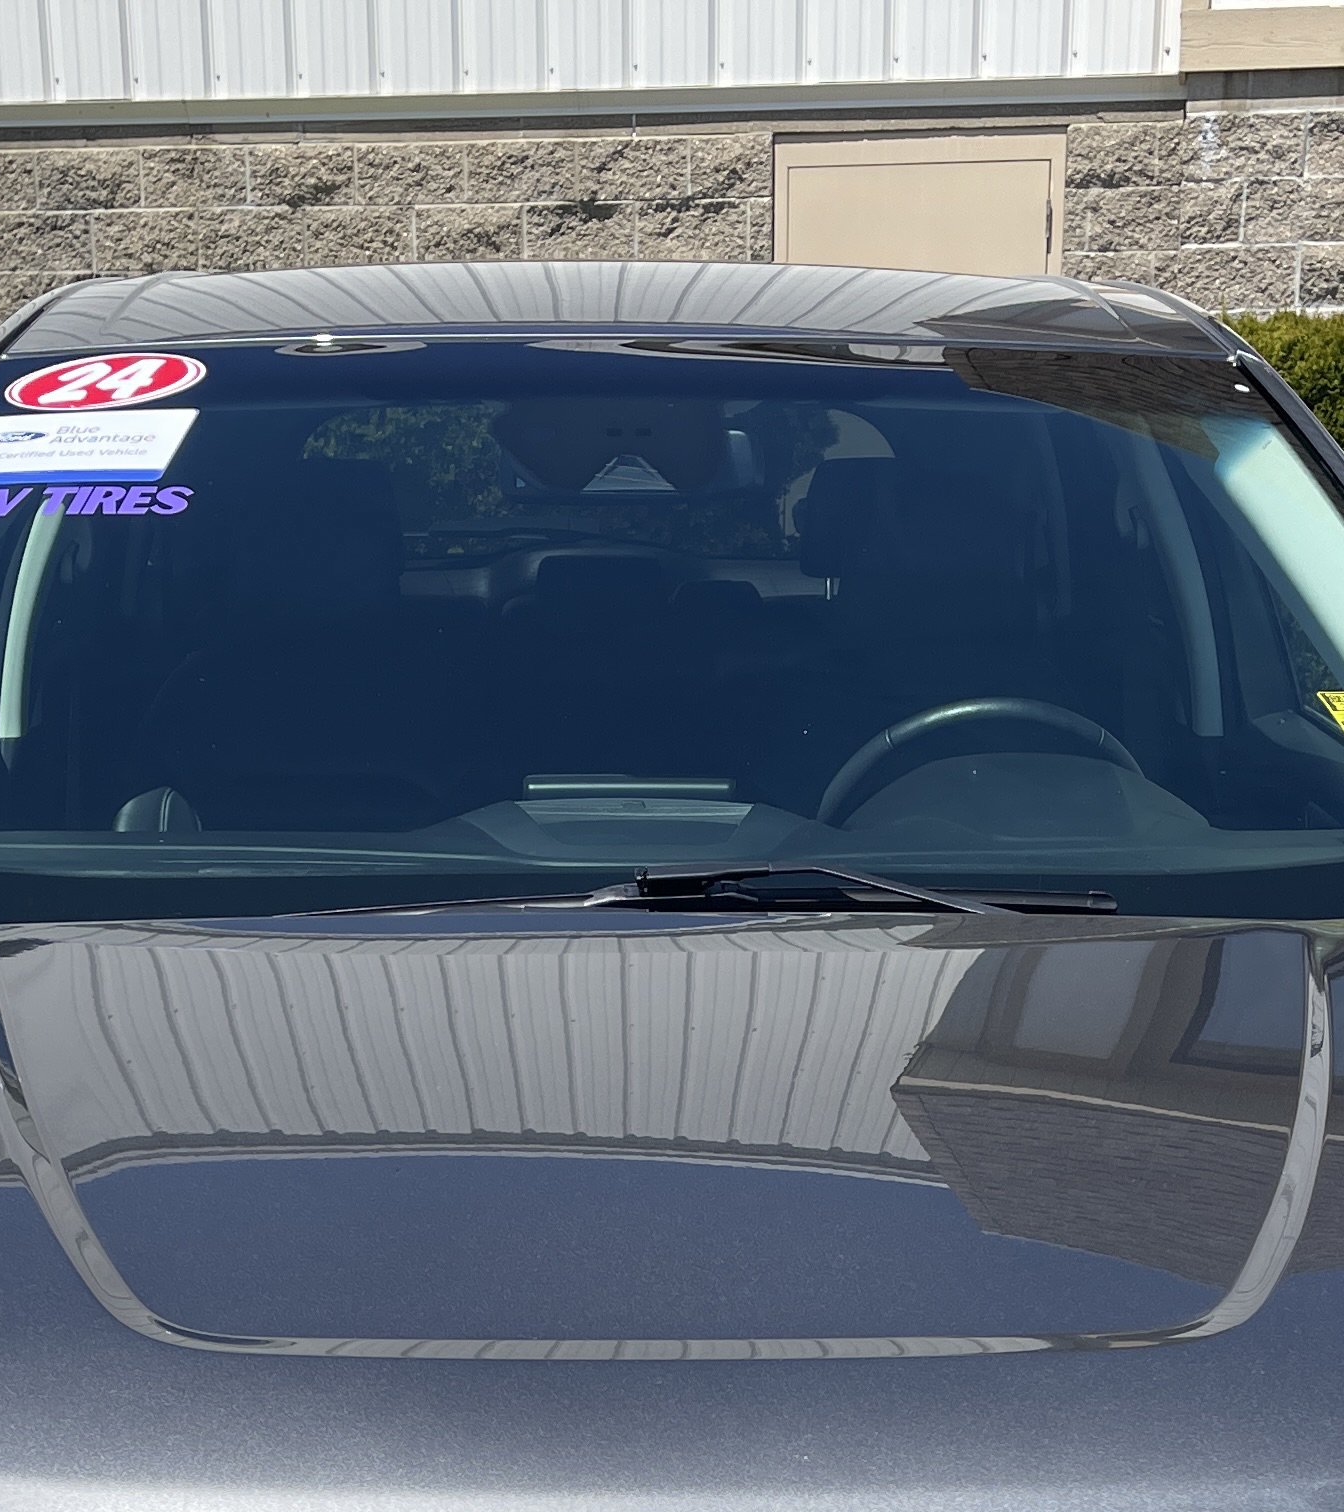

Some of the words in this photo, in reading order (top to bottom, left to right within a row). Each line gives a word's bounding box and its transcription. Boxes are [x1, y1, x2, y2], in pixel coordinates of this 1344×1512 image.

[37, 358, 167, 405] 24
[56, 425, 101, 435] Blue
[49, 433, 156, 444] Advantage
[58, 449, 95, 457] Used
[99, 447, 148, 457] Vehicle
[42, 485, 195, 516] TIRES
